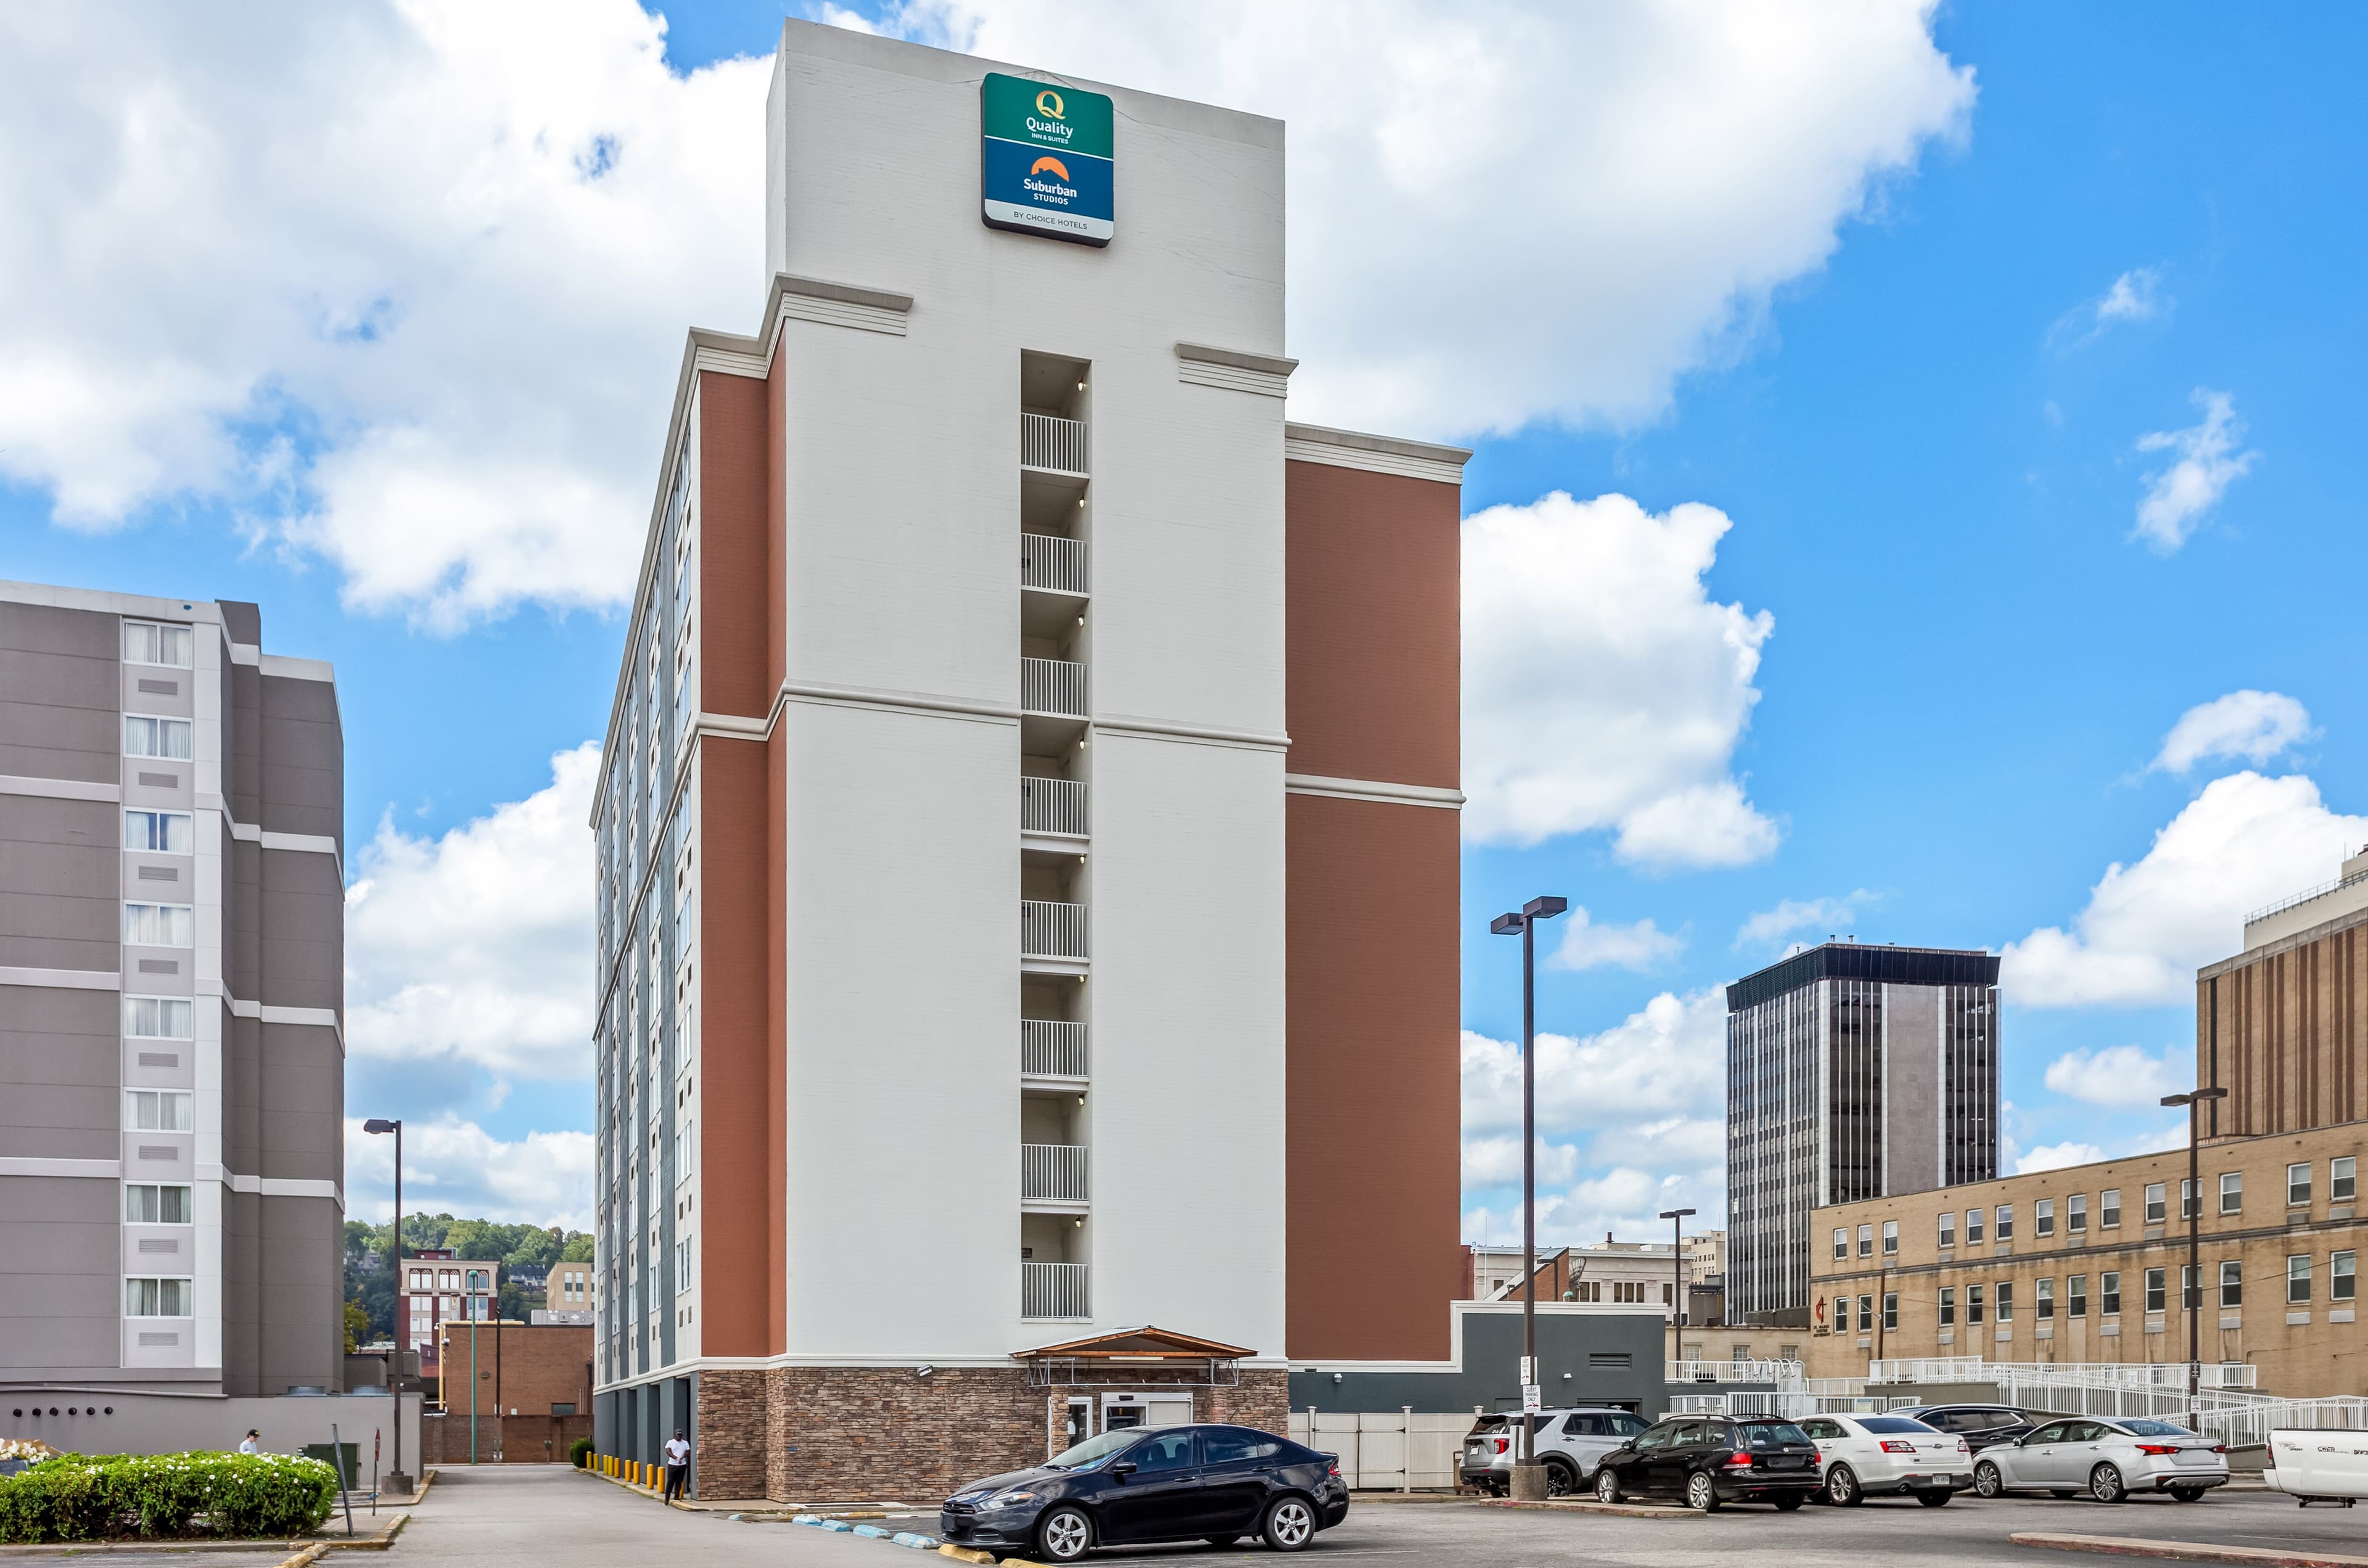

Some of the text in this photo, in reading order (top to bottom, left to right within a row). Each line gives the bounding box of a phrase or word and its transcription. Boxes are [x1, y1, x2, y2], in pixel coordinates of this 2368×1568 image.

[1026, 117, 1074, 139] Quality
[1048, 136, 1069, 144] SUITES
[1024, 178, 1077, 198] Suburban
[1034, 192, 1069, 205] STUDIOS
[1026, 213, 1055, 224] CHOICE
[1058, 219, 1088, 230] HOTELS
